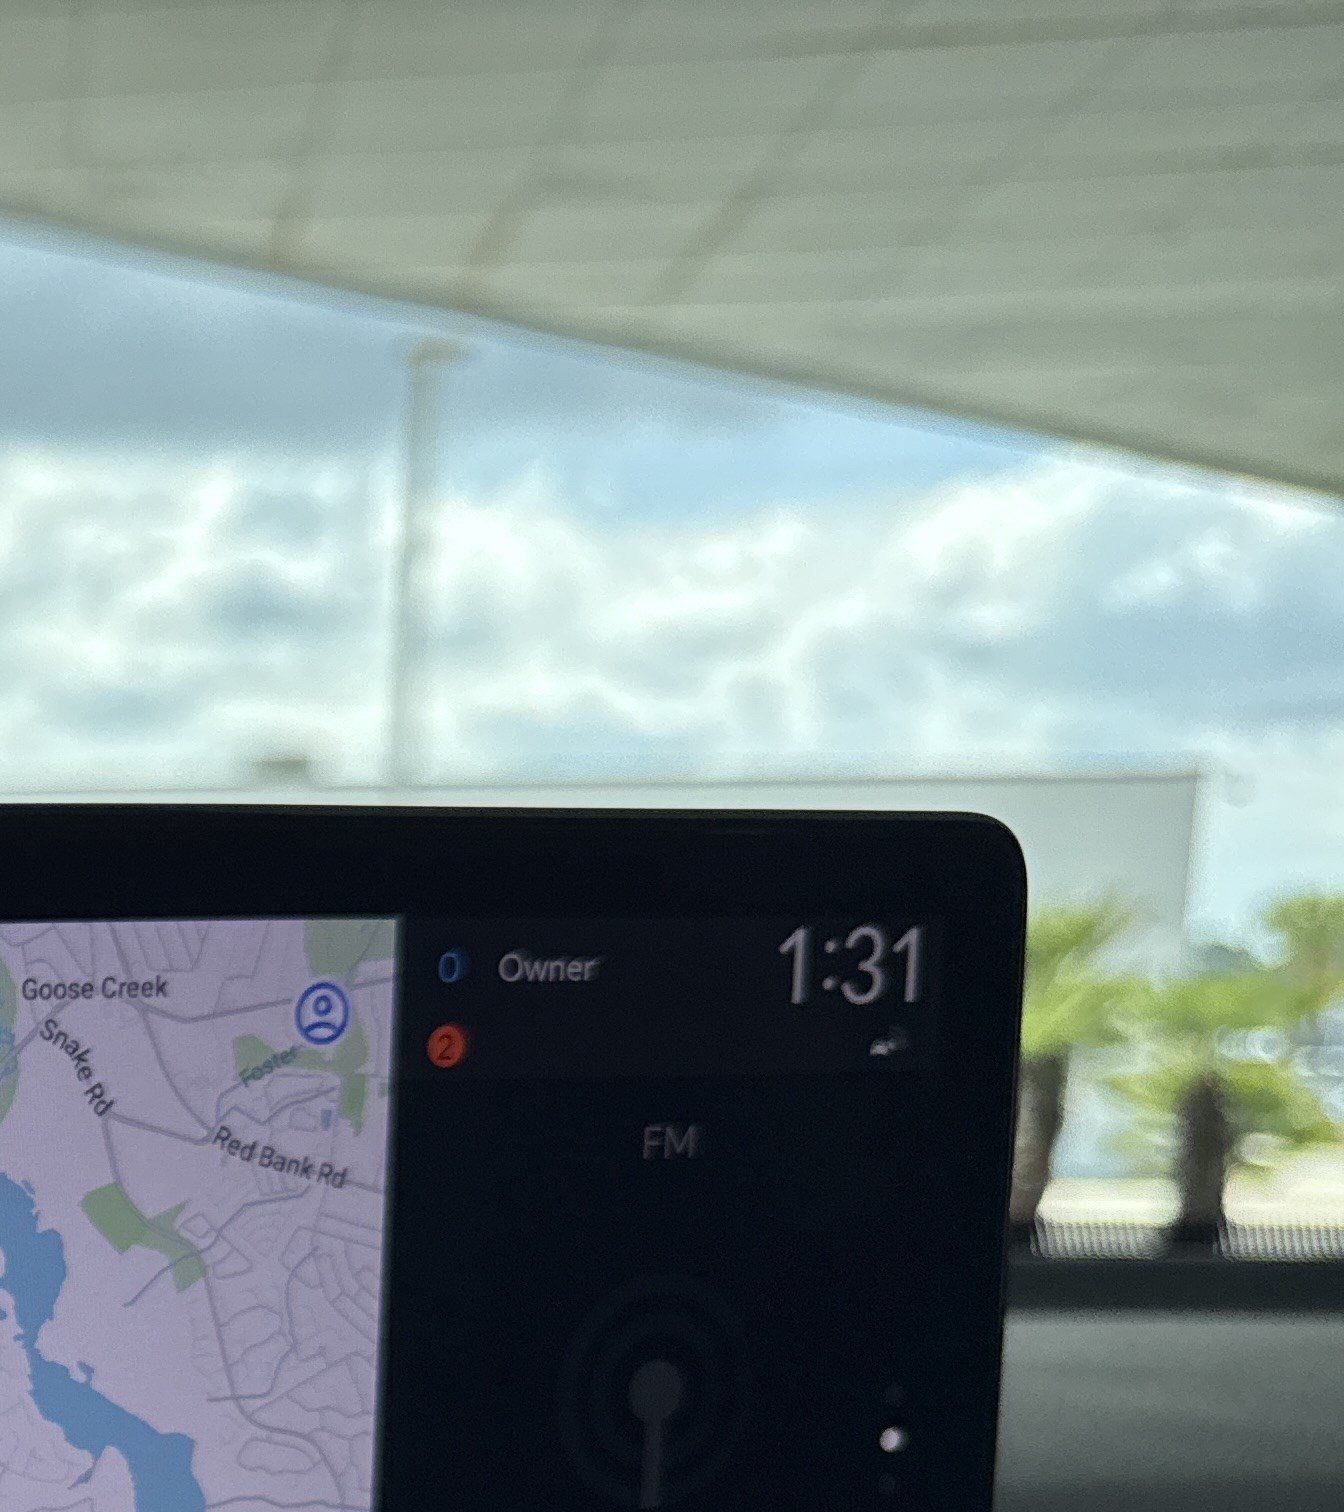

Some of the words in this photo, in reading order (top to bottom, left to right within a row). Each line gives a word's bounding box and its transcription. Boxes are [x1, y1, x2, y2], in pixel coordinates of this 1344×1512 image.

[22, 978, 93, 1001] Goose
[101, 976, 168, 998] Creek
[499, 952, 599, 982] Owner
[779, 925, 924, 1005] 1:31
[39, 1019, 95, 1081] Snake
[83, 1078, 114, 1117] Rd
[211, 1126, 256, 1163] Red
[259, 1148, 311, 1181] Bank
[316, 1165, 347, 1189] Rd
[642, 1125, 700, 1159] FM
